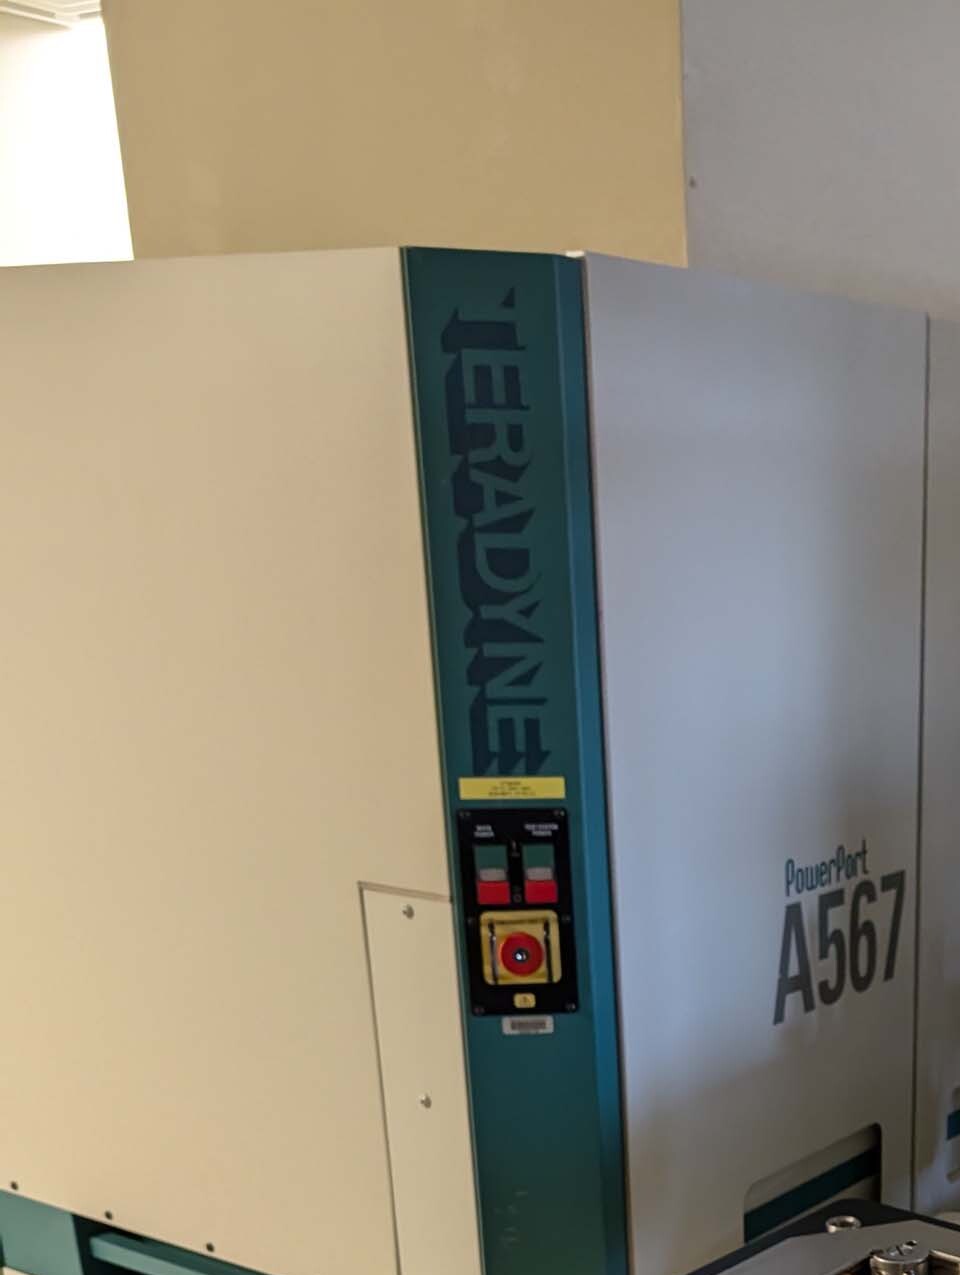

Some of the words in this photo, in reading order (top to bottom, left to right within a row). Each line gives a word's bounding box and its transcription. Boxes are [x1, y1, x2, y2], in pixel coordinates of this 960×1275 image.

[440, 286, 553, 780] TERADYNE
[784, 836, 870, 897] PowerPort
[772, 870, 906, 1026] A567
